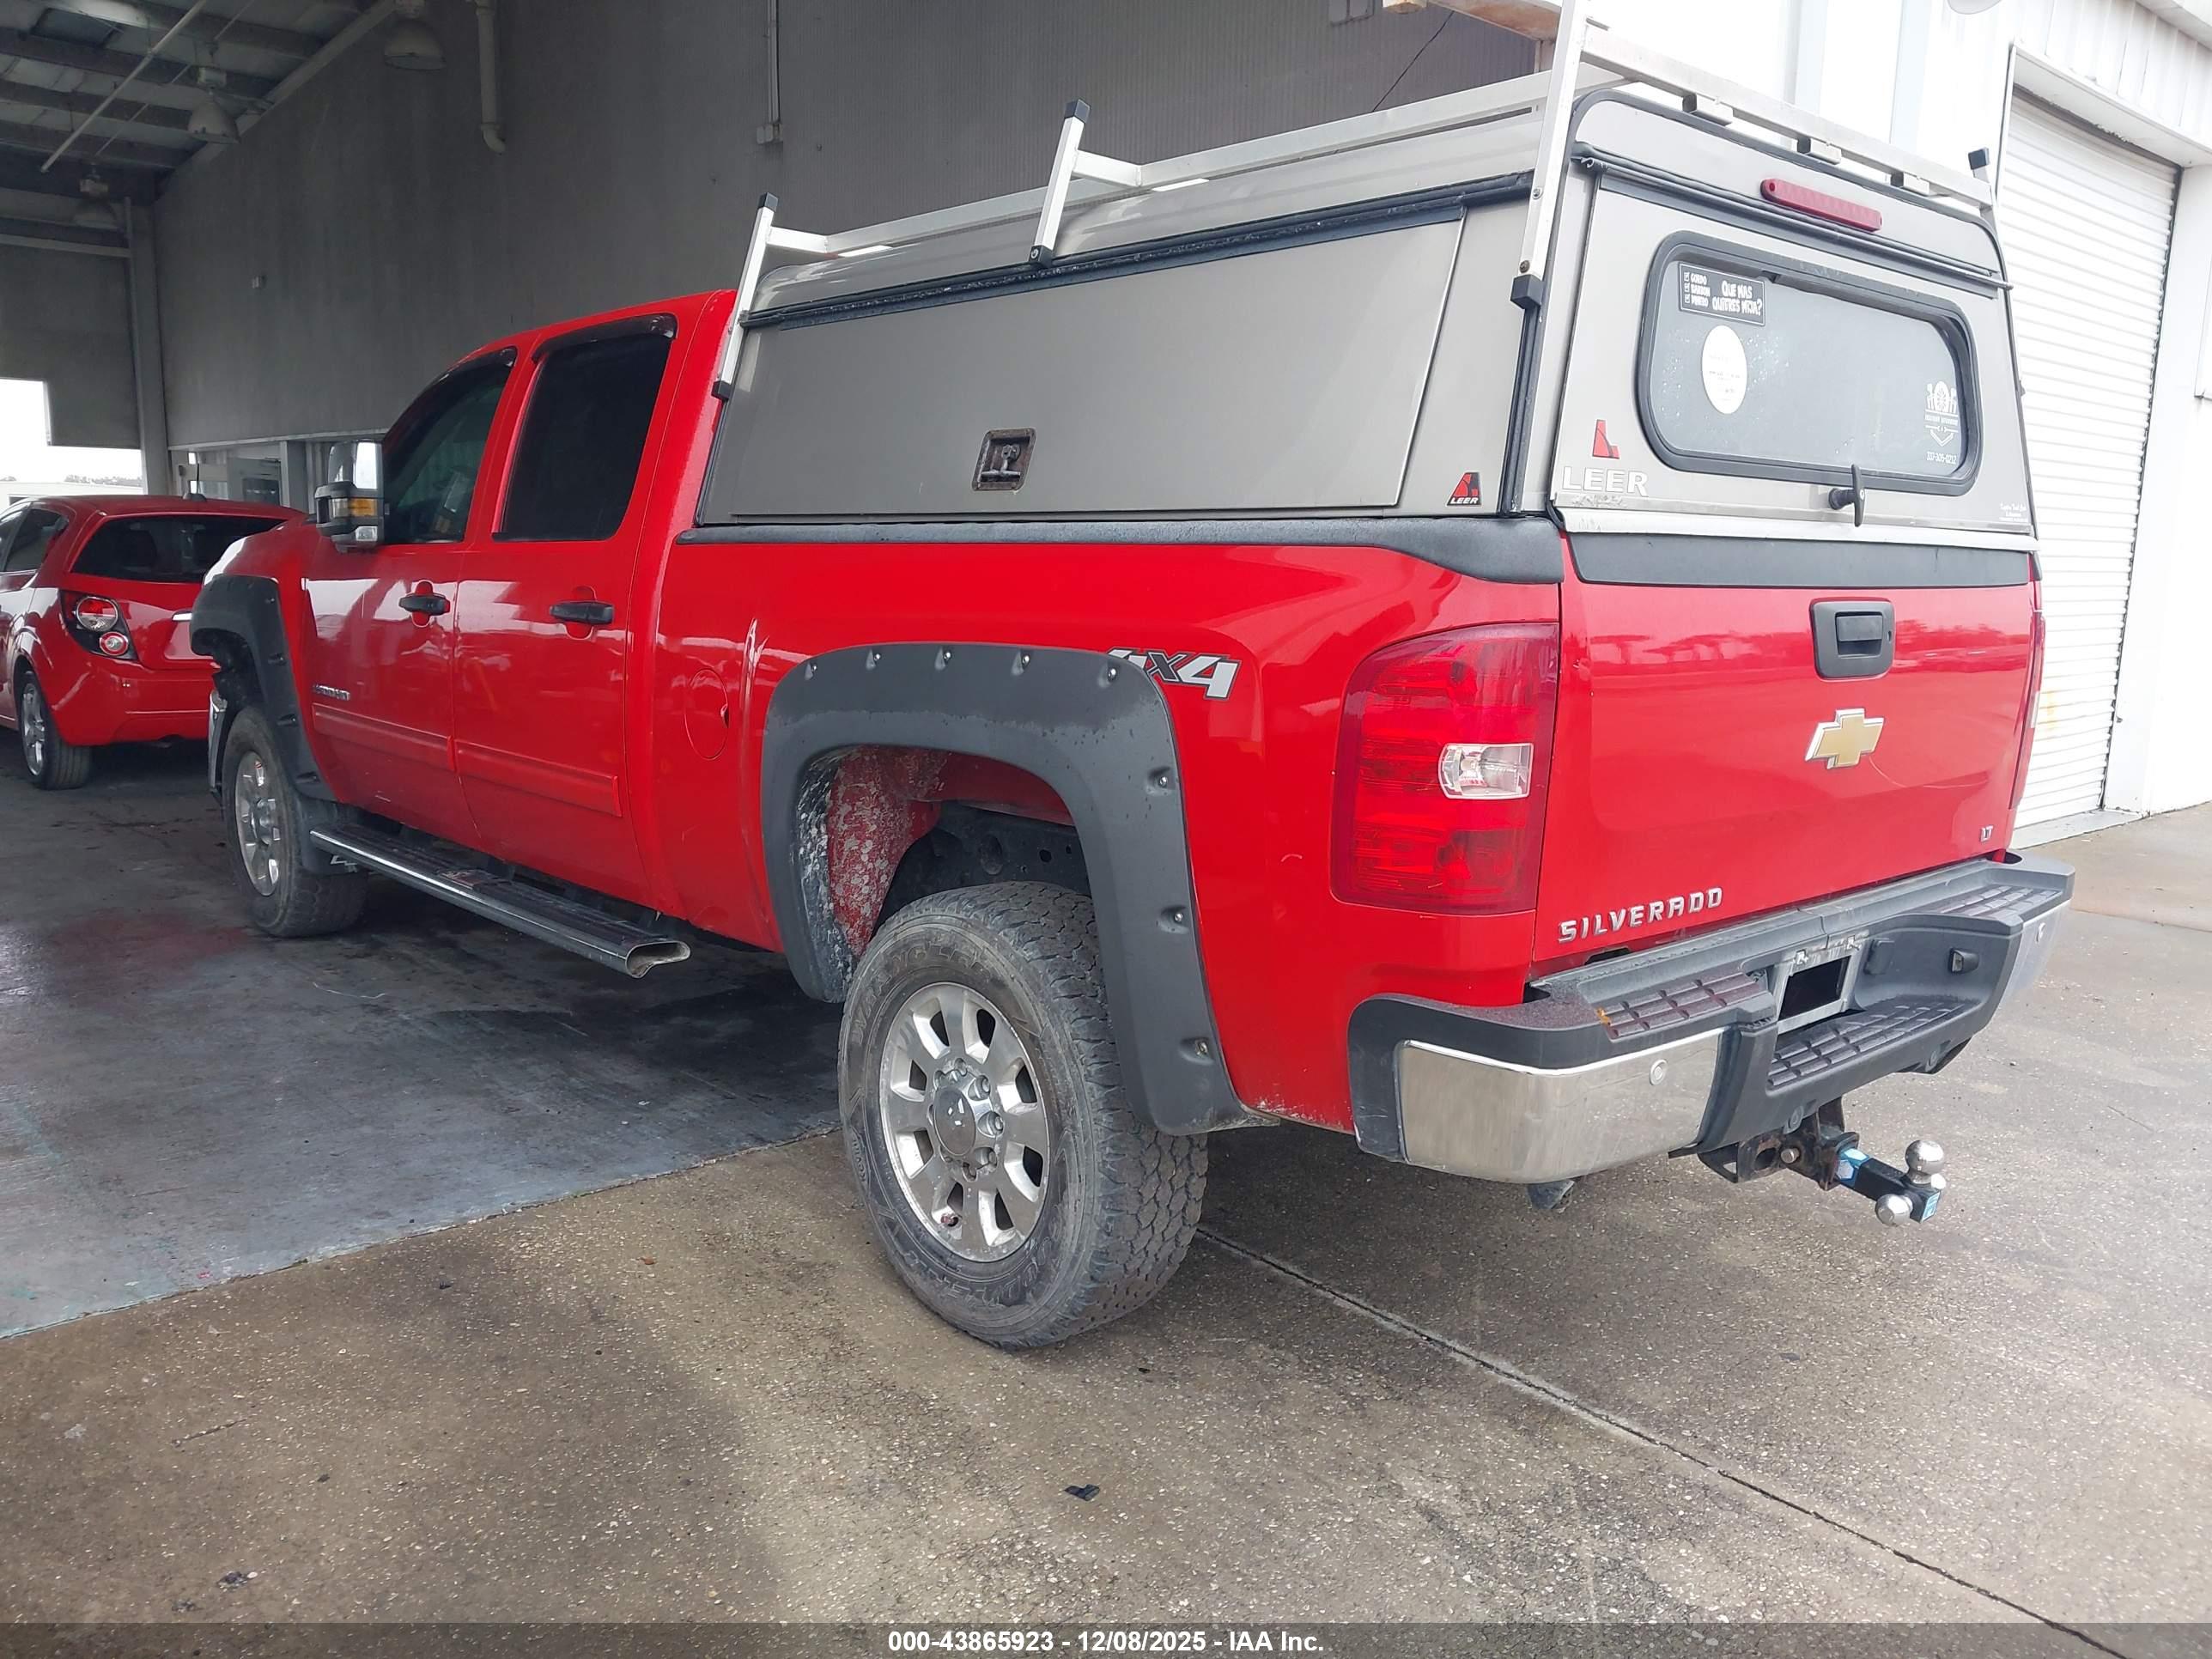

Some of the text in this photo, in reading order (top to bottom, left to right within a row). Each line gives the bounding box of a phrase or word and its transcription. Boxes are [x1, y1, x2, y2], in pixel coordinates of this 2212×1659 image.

[1721, 280, 1753, 299] QUE MAS
[1562, 466, 1649, 497] LEER
[1449, 496, 1479, 505] LEER
[1979, 824, 1994, 842] LT
[1558, 886, 1723, 944] SILVERADO
